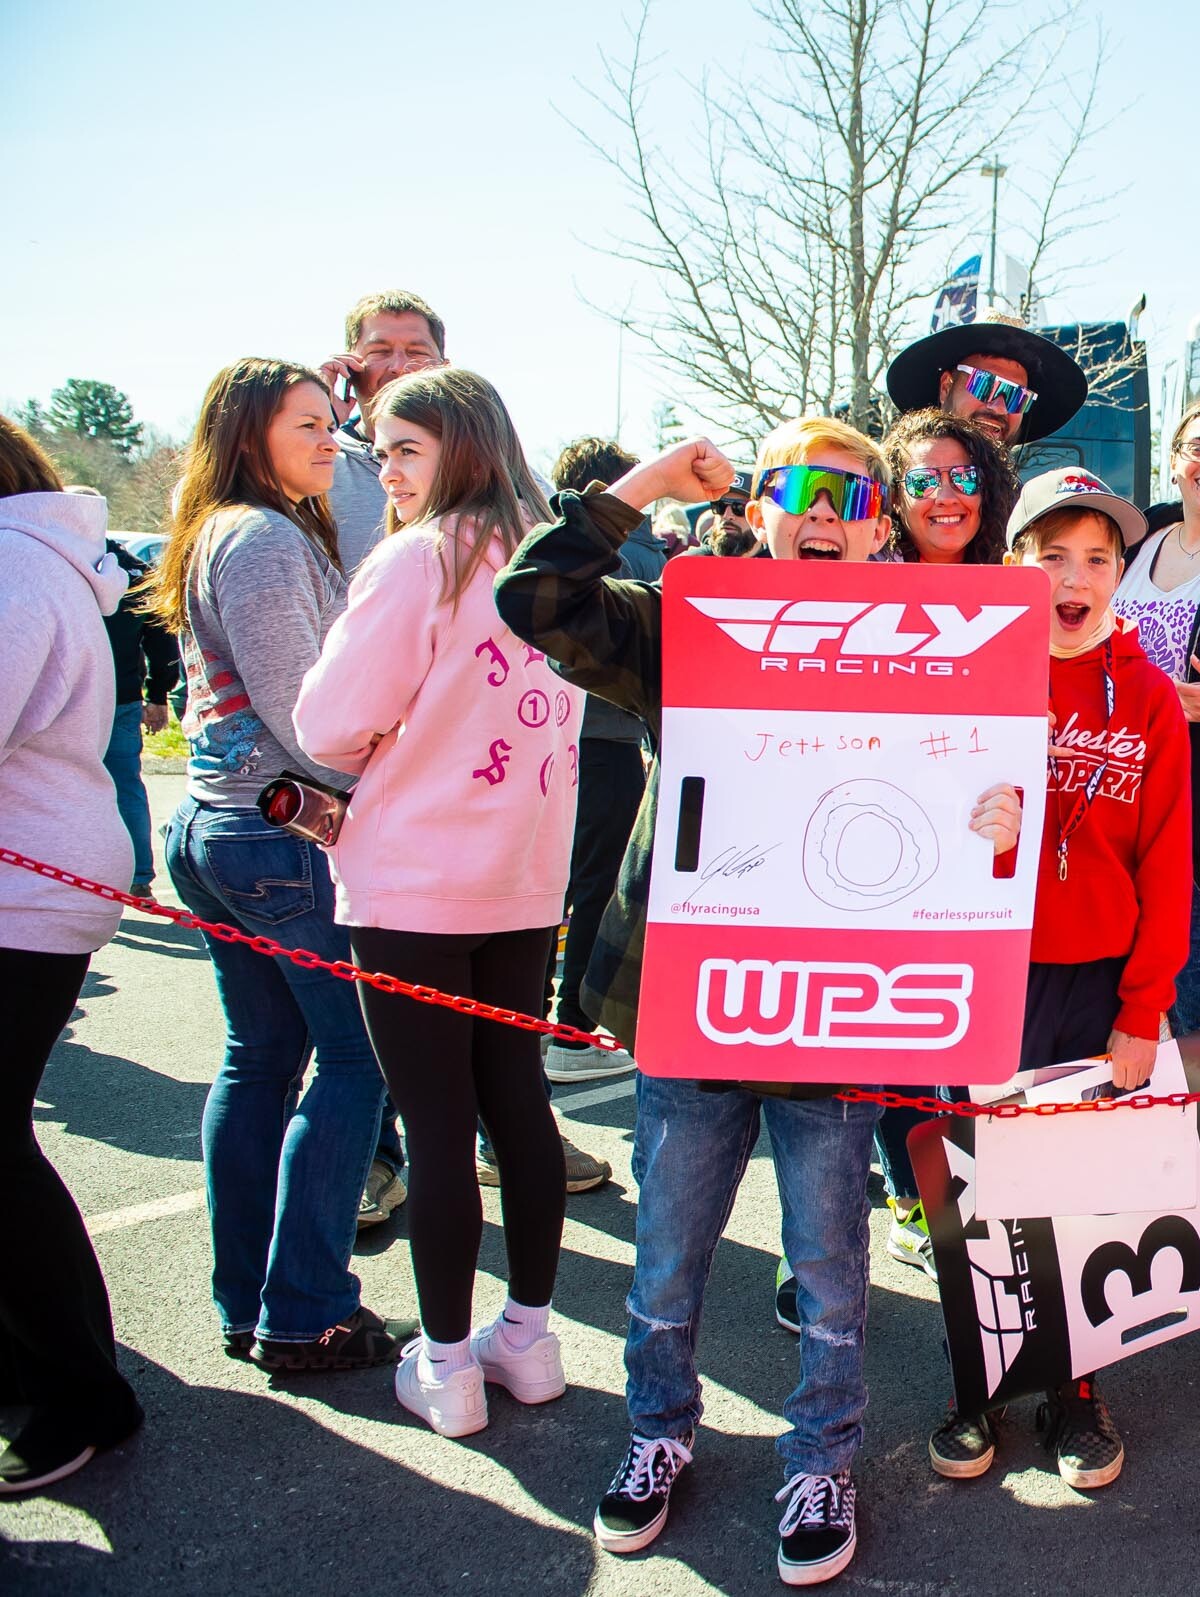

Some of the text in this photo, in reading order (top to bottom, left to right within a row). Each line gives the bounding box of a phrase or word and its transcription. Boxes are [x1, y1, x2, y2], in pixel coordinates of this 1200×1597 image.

[684, 597, 1031, 658] FLY
[760, 656, 954, 676] RACING
[1054, 712, 1147, 761] hester
[670, 902, 761, 917] @flyracingusa
[912, 907, 1014, 923] #fearlesspursuit
[696, 958, 974, 1050] WPS
